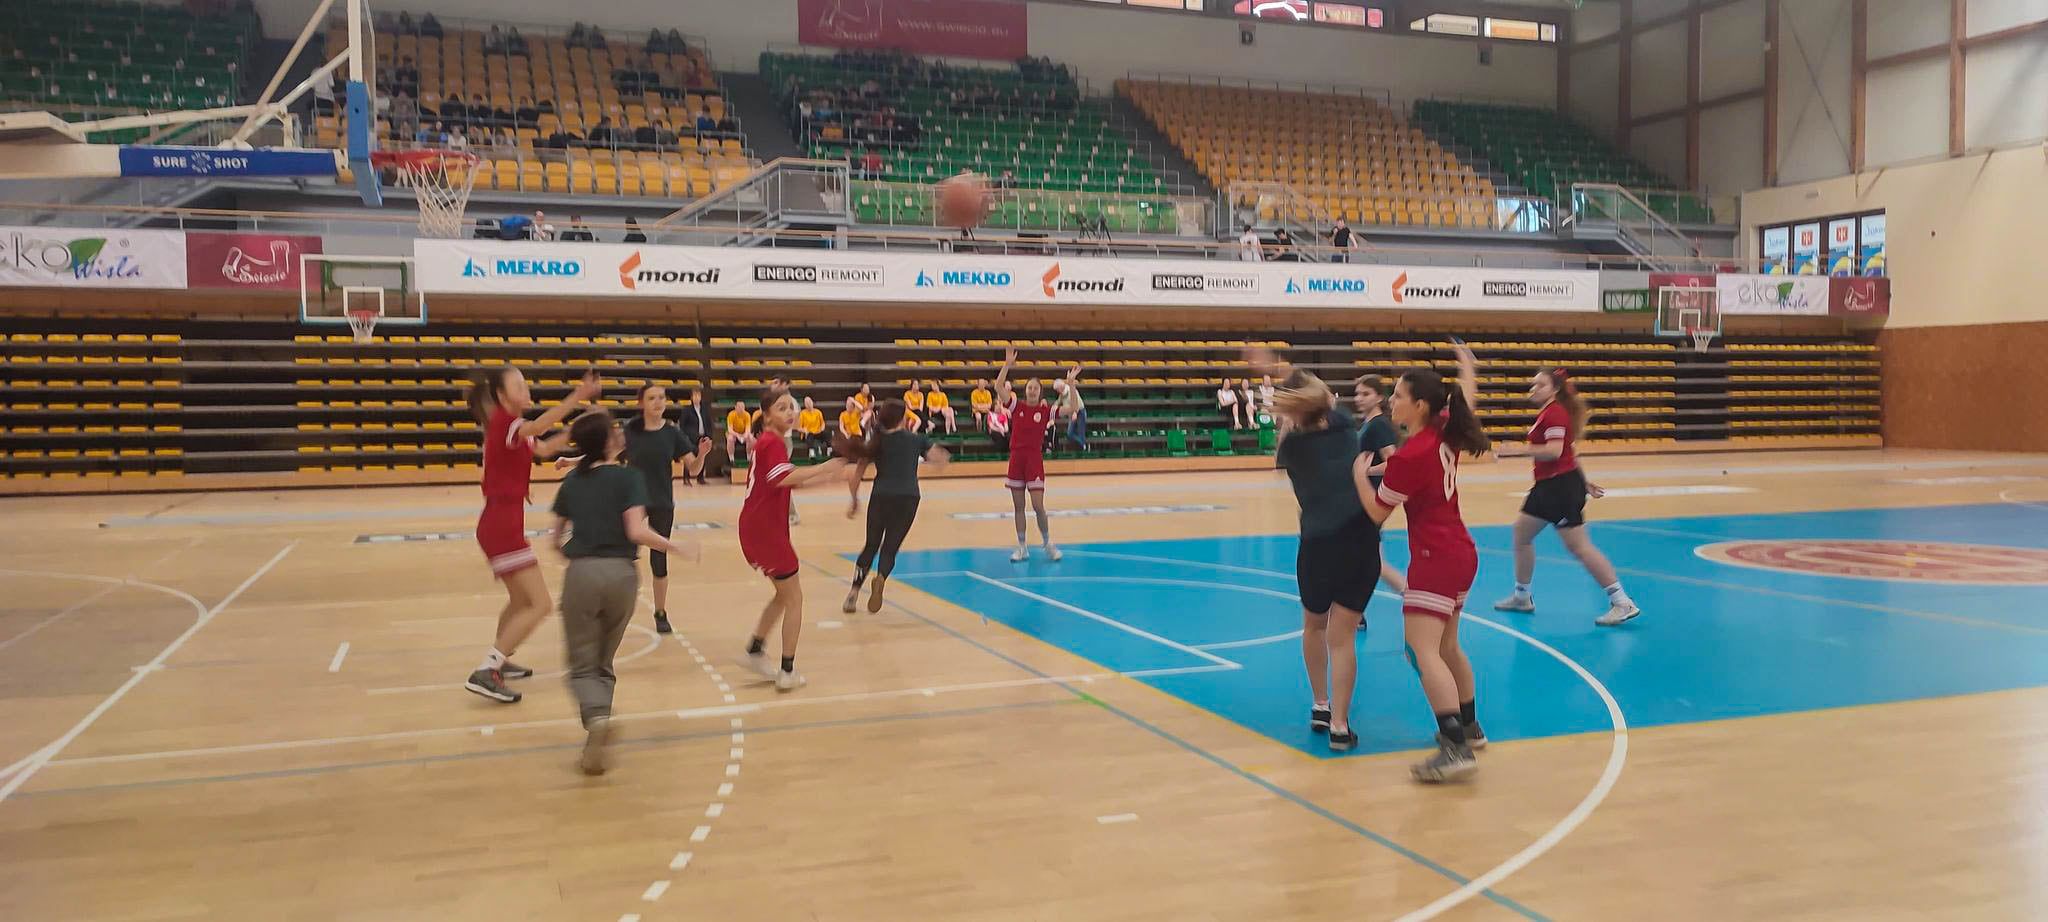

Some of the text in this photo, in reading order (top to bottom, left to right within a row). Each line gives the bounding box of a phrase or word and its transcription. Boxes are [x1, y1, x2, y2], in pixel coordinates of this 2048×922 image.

[152, 156, 249, 169] SURE SHOT
[0, 231, 72, 273] ko
[496, 259, 580, 276] MEKRO
[757, 266, 880, 283] ENERGO REMONT
[637, 267, 721, 285] mondi
[943, 271, 1011, 286] MEKRO
[1156, 275, 1256, 290] ENERGO REMONT
[1057, 277, 1125, 293] mondi
[1308, 279, 1365, 293] MEKRO
[1404, 284, 1462, 298] mondi
[1485, 282, 1571, 296] ENERGO REMONT
